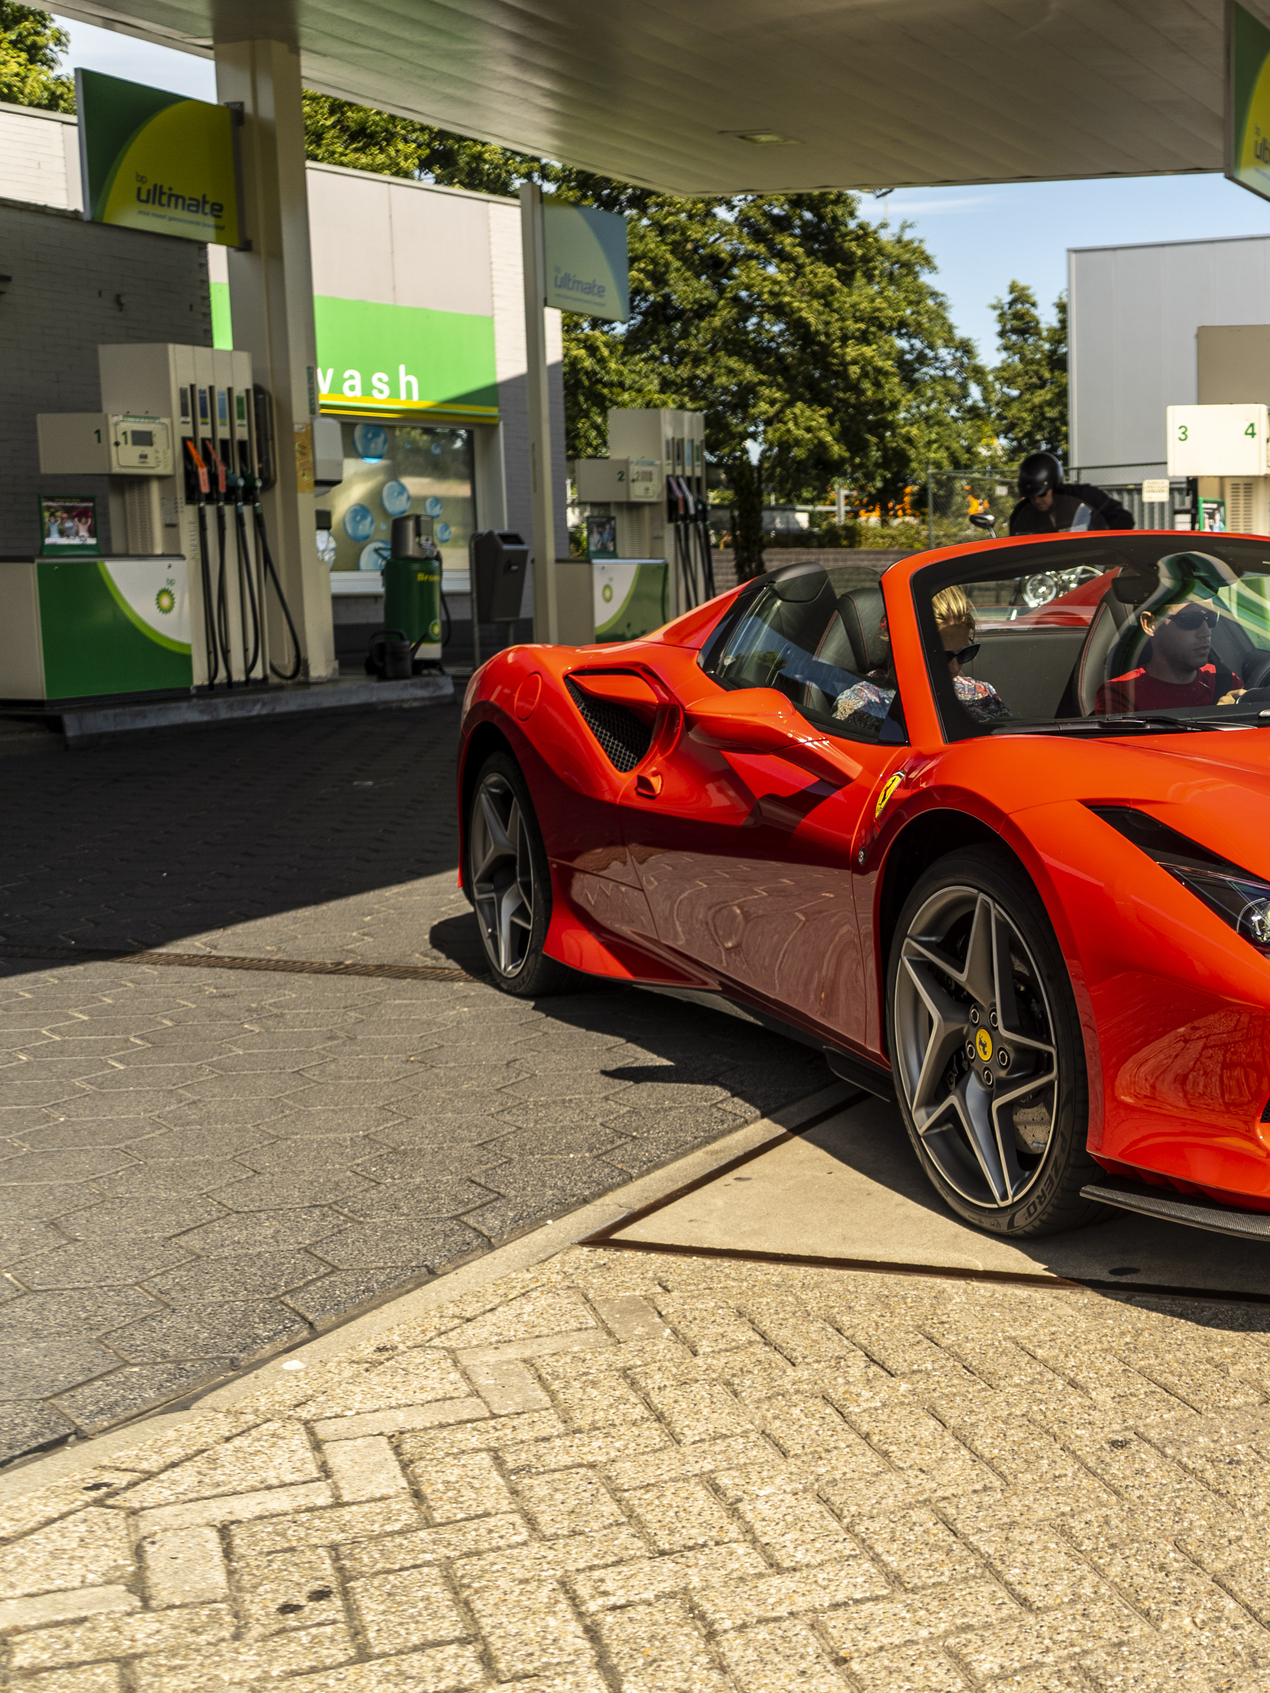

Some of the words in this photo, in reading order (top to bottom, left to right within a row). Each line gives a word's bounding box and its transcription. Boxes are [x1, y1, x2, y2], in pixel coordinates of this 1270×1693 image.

[136, 183, 224, 219] ultimate
[554, 272, 606, 298] ultimate
[94, 428, 102, 444] 1
[121, 430, 129, 446] 1
[1178, 425, 1188, 442] 3
[1244, 422, 1257, 439] 4
[617, 470, 626, 482] 2
[1060, 1130, 1067, 1154] P
[1026, 1155, 1061, 1218] ZERO
